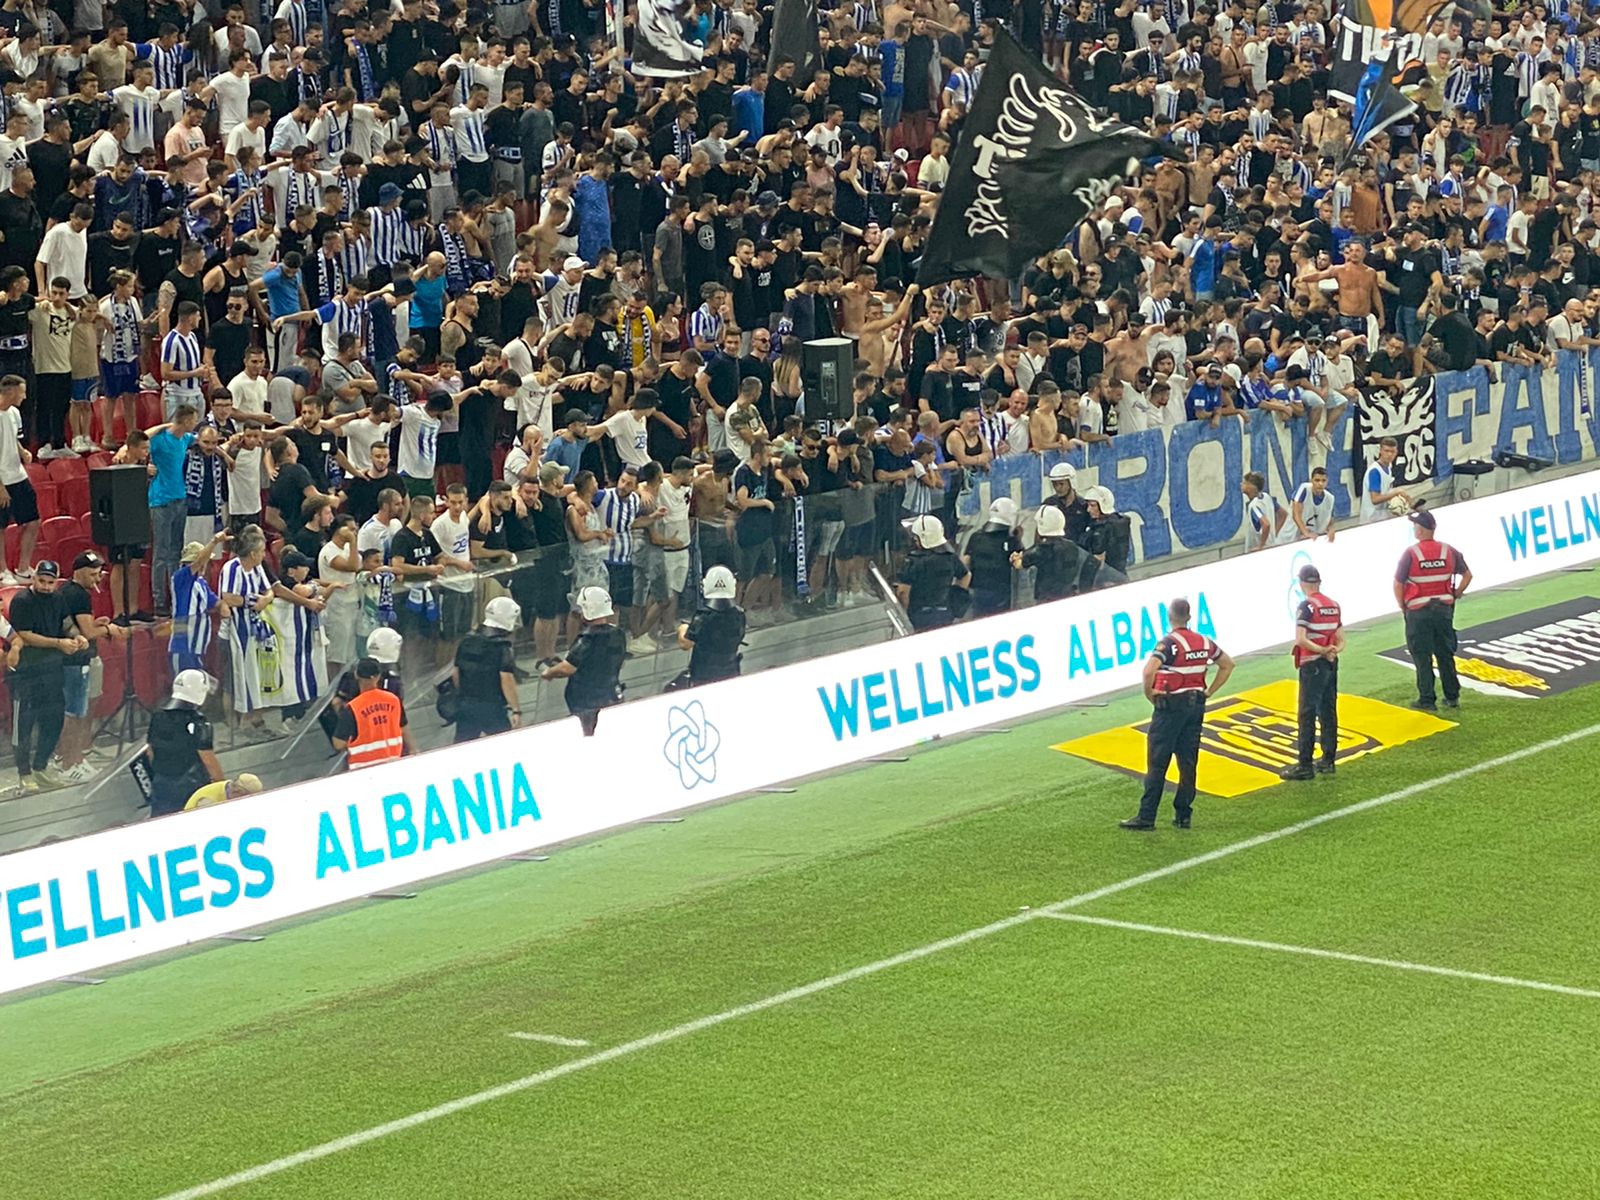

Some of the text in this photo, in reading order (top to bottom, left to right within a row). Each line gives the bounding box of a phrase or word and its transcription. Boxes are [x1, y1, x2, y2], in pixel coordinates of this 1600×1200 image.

[1420, 560, 1446, 569] POLICIA
[817, 591, 1217, 741] WELLNESS ALBAA
[0, 762, 542, 960] ELLNESS ALBANIA
